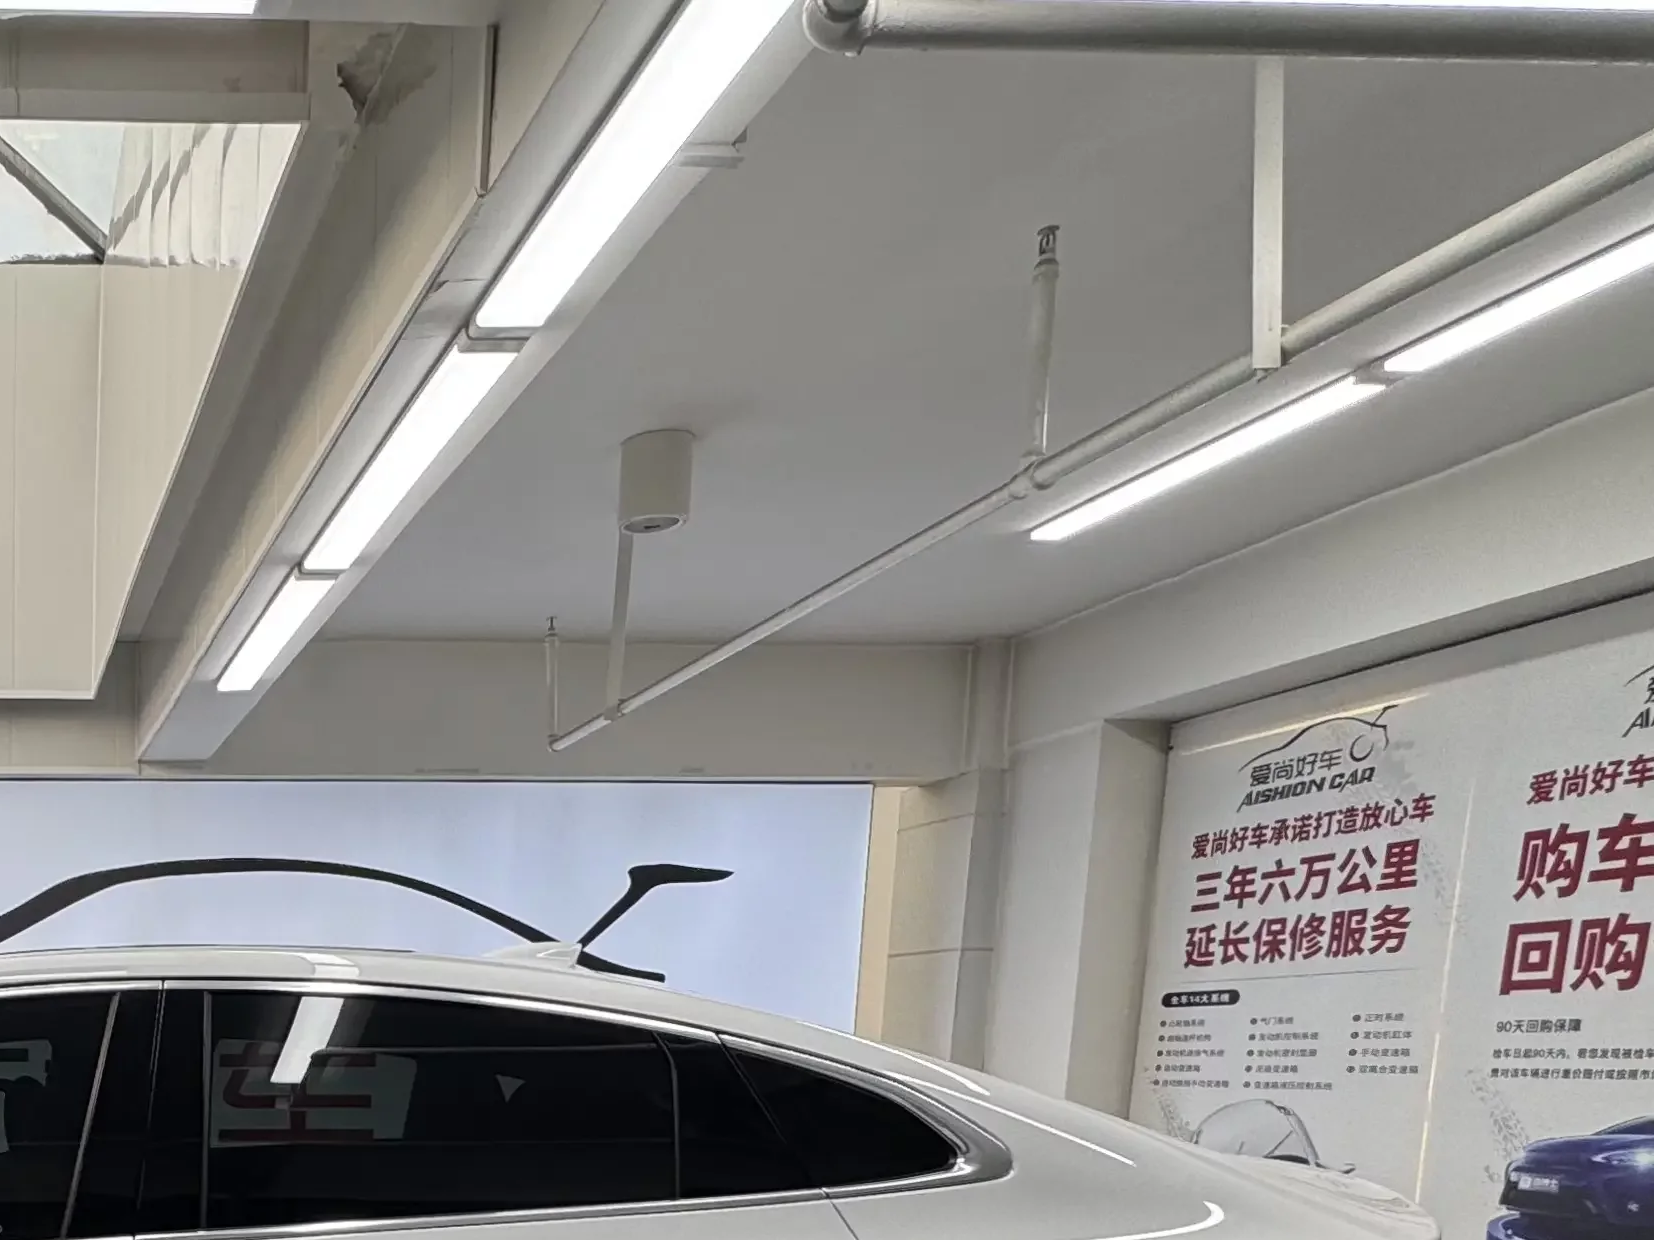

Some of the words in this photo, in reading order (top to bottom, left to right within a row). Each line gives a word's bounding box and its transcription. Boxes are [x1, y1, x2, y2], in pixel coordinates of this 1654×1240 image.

[1249, 748, 1344, 787] 爱尚好车
[1526, 754, 1654, 806] 爱尚好车
[1236, 777, 1326, 813] AISHION
[1329, 766, 1376, 793] CAR
[1191, 792, 1437, 859] 爱尚好车承诺打造放心车
[1190, 838, 1420, 913] 三年六万公里
[1513, 812, 1654, 902] 购车
[1183, 903, 1413, 969] 延长保修服务
[1498, 912, 1652, 996] 回购
[1257, 1031, 1320, 1042] 发动机控制系统
[1259, 1016, 1295, 1026] 气门系统
[1364, 1012, 1405, 1023] 正时系统
[1496, 1018, 1582, 1034] 90天回购保障
[1358, 1064, 1420, 1075] 双离合变速箱
[1360, 1047, 1412, 1058] 手动变速箱
